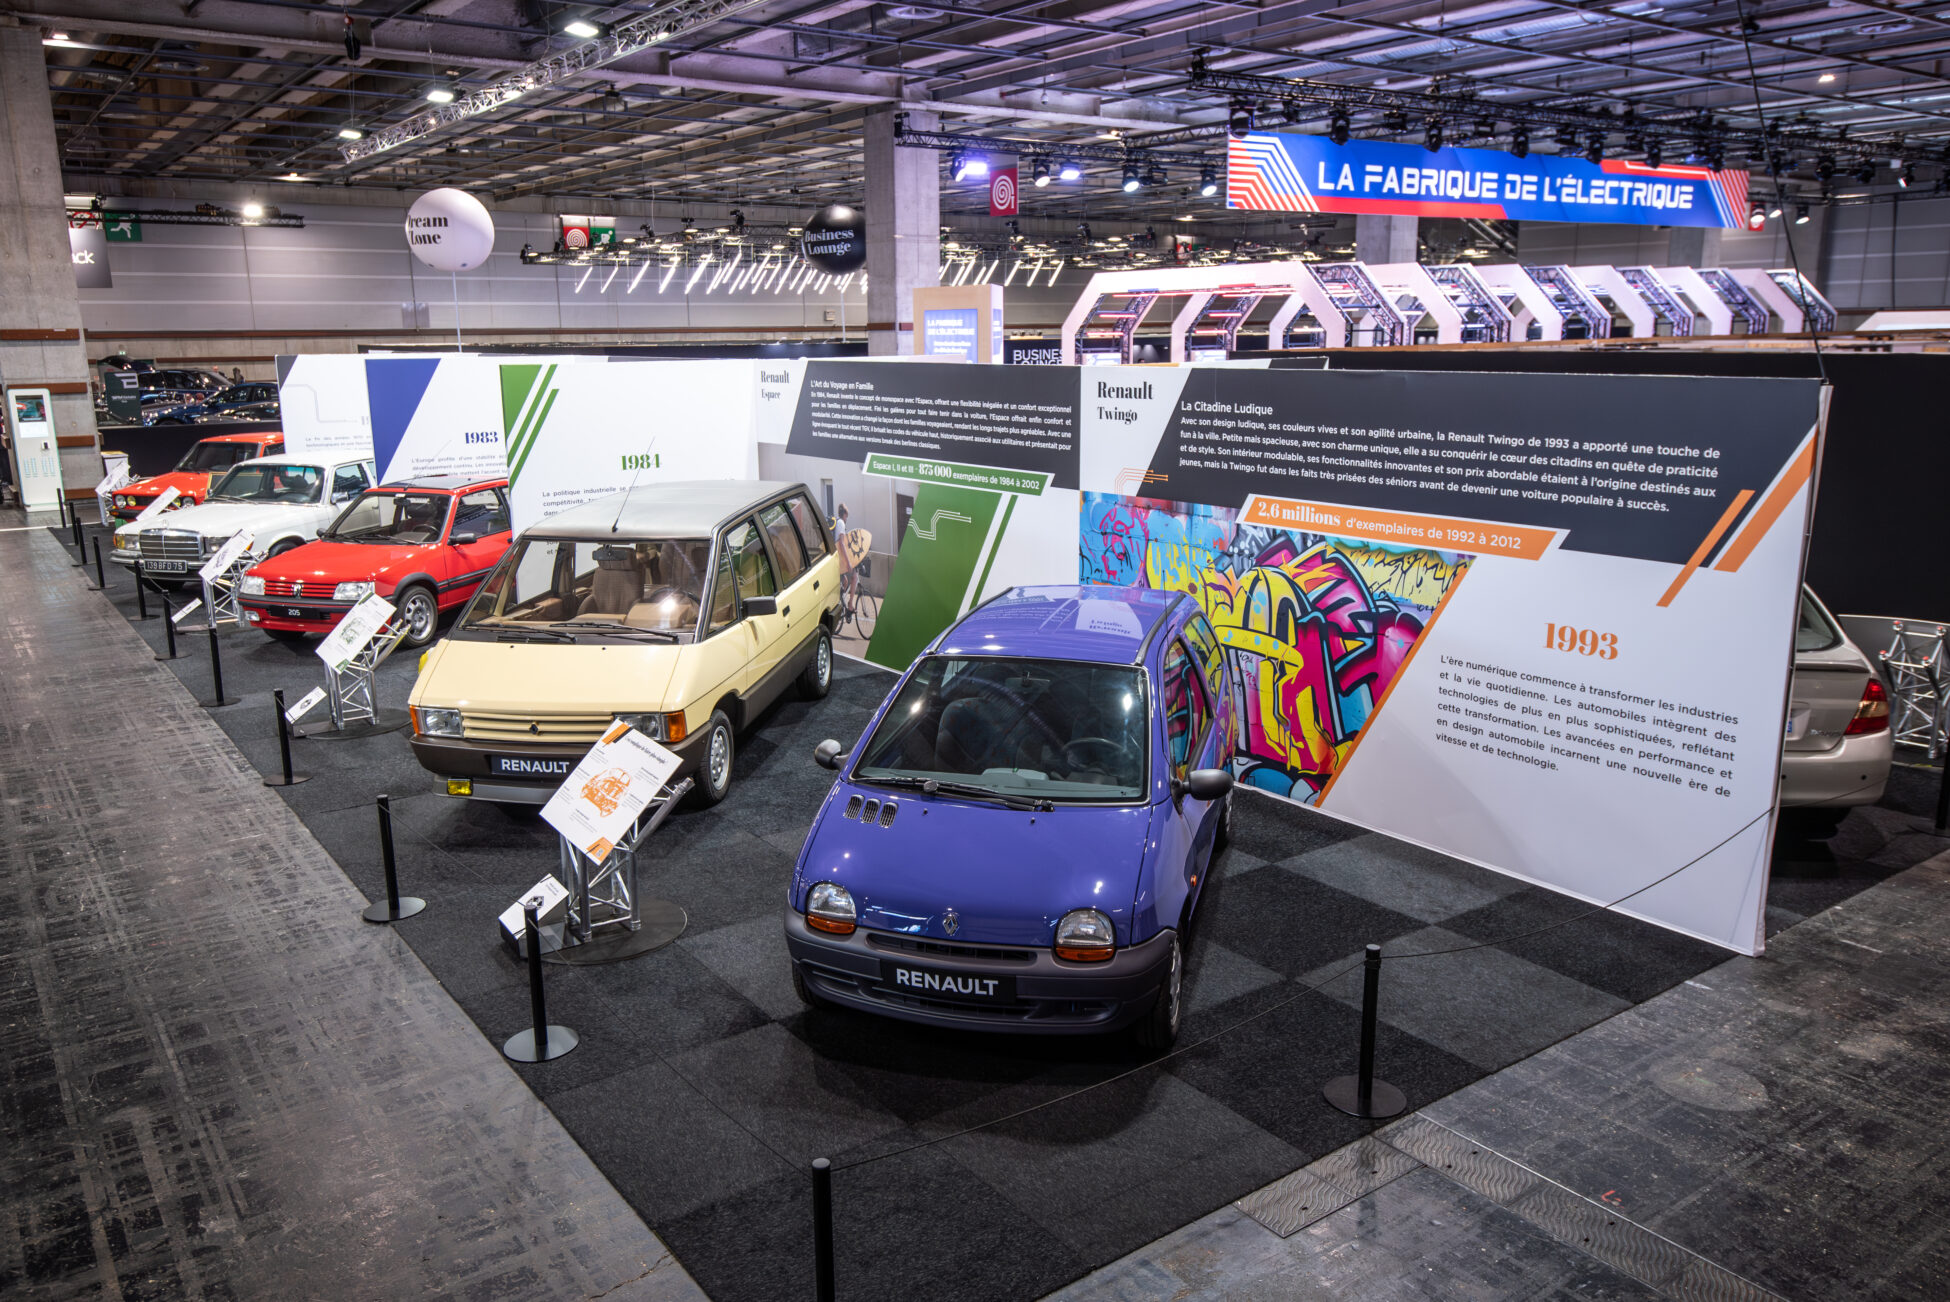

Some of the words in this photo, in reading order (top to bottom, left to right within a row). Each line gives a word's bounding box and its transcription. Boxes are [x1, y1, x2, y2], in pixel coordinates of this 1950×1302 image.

[1318, 161, 1355, 191] LA
[1364, 165, 1498, 199] FABRIQUE
[1504, 174, 1538, 201] DE
[1543, 174, 1694, 210] L'ÉLECTRIQUE
[805, 229, 854, 242] Business
[808, 242, 851, 256] Lounge
[761, 370, 789, 383] Renault
[830, 381, 848, 390] Voyage
[856, 382, 874, 390] Famille
[1098, 381, 1152, 400] Renault
[761, 388, 781, 401] Espace
[1181, 401, 1192, 411] La
[1194, 401, 1232, 413] Citadine
[1234, 403, 1273, 416] Ludique
[1097, 406, 1138, 425] Twingo
[465, 431, 498, 444] 1983
[1181, 417, 1197, 425] Avec
[1213, 418, 1236, 429] design
[1238, 420, 1266, 430] ludique,
[1282, 423, 1315, 433] couleurs
[1318, 425, 1338, 434] vives
[1340, 427, 1349, 435] et
[1368, 428, 1395, 439] agilité
[1398, 430, 1434, 441] urbaine,
[1437, 431, 1445, 441] la
[1448, 432, 1485, 443] Renault
[1488, 434, 1525, 447] Twingo
[1528, 437, 1541, 447] de
[1545, 438, 1570, 449] 1993
[1582, 442, 1628, 453] apporté
[1632, 445, 1654, 454] une
[1658, 445, 1700, 457] touche
[1704, 448, 1720, 459] de
[620, 454, 661, 470] 1984
[1180, 430, 1192, 438] fun
[1205, 432, 1221, 441] ville.
[1222, 433, 1243, 442] Petite
[1244, 435, 1261, 444] mais
[1262, 437, 1300, 448] spacieuse,
[1338, 442, 1368, 452] charme
[1370, 444, 1402, 455] unique,
[1404, 446, 1420, 456] elle
[1441, 450, 1488, 460] conquérir
[1490, 451, 1498, 461] le
[1500, 454, 1528, 463] cœur
[1530, 454, 1548, 465] des
[1550, 456, 1593, 468] citadins
[1595, 461, 1609, 470] en
[1612, 461, 1646, 472] quête
[1648, 463, 1664, 474] de
[1666, 466, 1718, 478] praticité
[873, 461, 891, 470] Espace
[919, 463, 934, 476] 875
[934, 465, 952, 478] 000
[953, 472, 988, 483] exemplaires
[990, 476, 998, 484] de
[1016, 479, 1020, 487] à
[1022, 479, 1040, 490] 2002
[1258, 502, 1280, 518] 2,6
[1282, 506, 1341, 526] millions
[1346, 518, 1424, 537] d'exemplaires
[1428, 527, 1443, 539] de
[1447, 529, 1475, 543] 1992
[1479, 533, 1486, 545] à
[1490, 534, 1521, 549] 2012
[1544, 622, 1618, 660] 1993
[1441, 655, 1464, 667] L'ère
[1466, 662, 1518, 678] numérique
[1520, 673, 1576, 691] commence
[1580, 683, 1586, 693] à
[1589, 686, 1655, 707] transformer
[1659, 699, 1675, 711] les
[1678, 704, 1738, 725] industries
[1454, 673, 1462, 683] la
[1467, 677, 1481, 687] vie
[1486, 682, 1548, 702] quotidienne.
[1554, 695, 1572, 707] Les
[1578, 702, 1646, 723] automobiles
[1653, 716, 1707, 737] intègrent
[1714, 730, 1736, 743] des
[1439, 686, 1498, 707] technologies
[1504, 701, 1516, 711] de
[1522, 706, 1542, 717] plus
[1548, 712, 1560, 721] en
[1566, 716, 1588, 728] plus
[1594, 723, 1675, 749] sophistiquées,
[1682, 743, 1734, 761] reflétant
[1436, 733, 1467, 747] vitesse
[1470, 742, 1479, 750] et
[1482, 744, 1494, 754] de
[1497, 748, 1558, 771] technologie.
[1438, 703, 1461, 714] cette
[1465, 708, 1539, 733] transformation.
[1544, 726, 1561, 738] Les
[1566, 733, 1615, 751] avancées
[1620, 746, 1634, 755] en
[1638, 751, 1715, 775] performance
[1720, 770, 1733, 780] et
[501, 758, 570, 773] RENAULT
[1437, 718, 1448, 727] en
[1453, 721, 1484, 736] design
[1489, 731, 1545, 751] automobile
[1551, 744, 1600, 765] incarnent
[1606, 760, 1627, 771] une
[1633, 767, 1682, 785] nouvelle
[1689, 779, 1708, 792] ère
[1715, 786, 1731, 797] de
[896, 968, 998, 996] RENAULT
